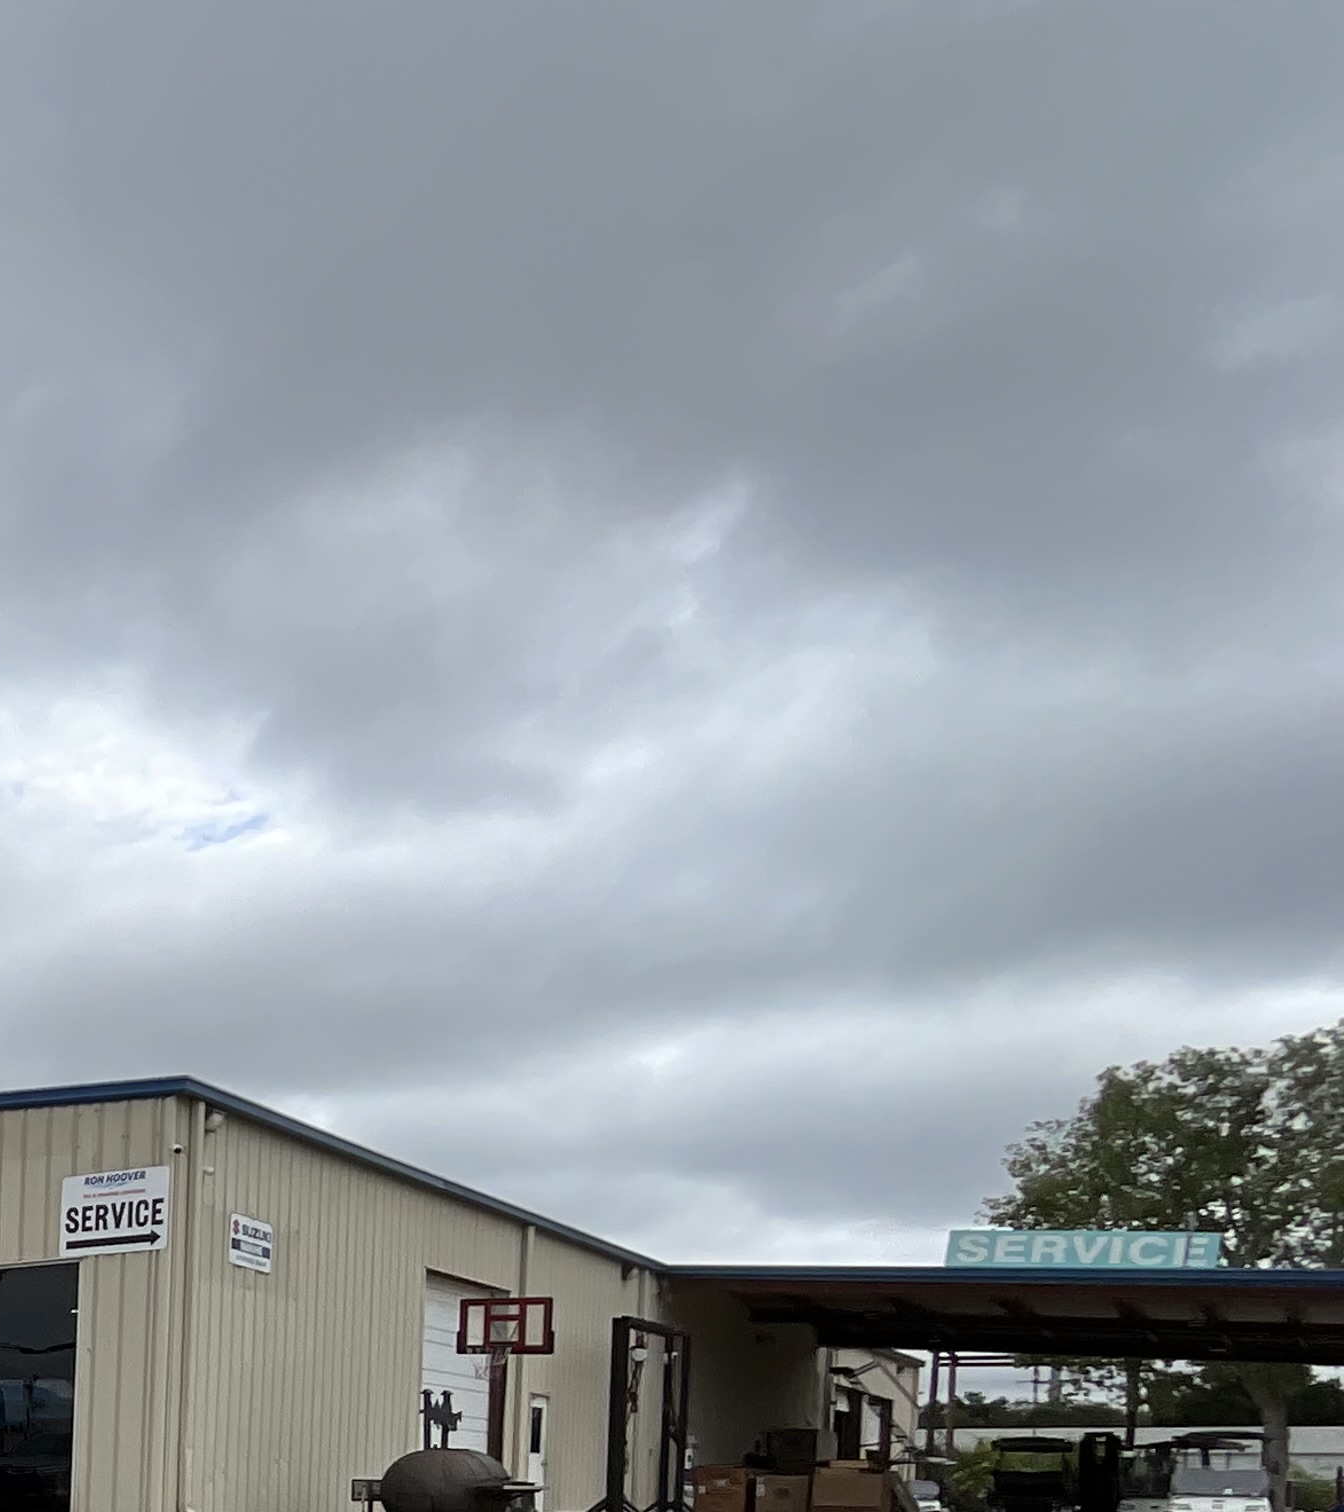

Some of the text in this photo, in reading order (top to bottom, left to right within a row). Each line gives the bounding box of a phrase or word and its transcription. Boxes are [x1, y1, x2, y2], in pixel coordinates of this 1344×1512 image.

[83, 1170, 147, 1186] RON HOOVER
[65, 1197, 165, 1234] SERVICE
[956, 1234, 1209, 1266] SERVICE
